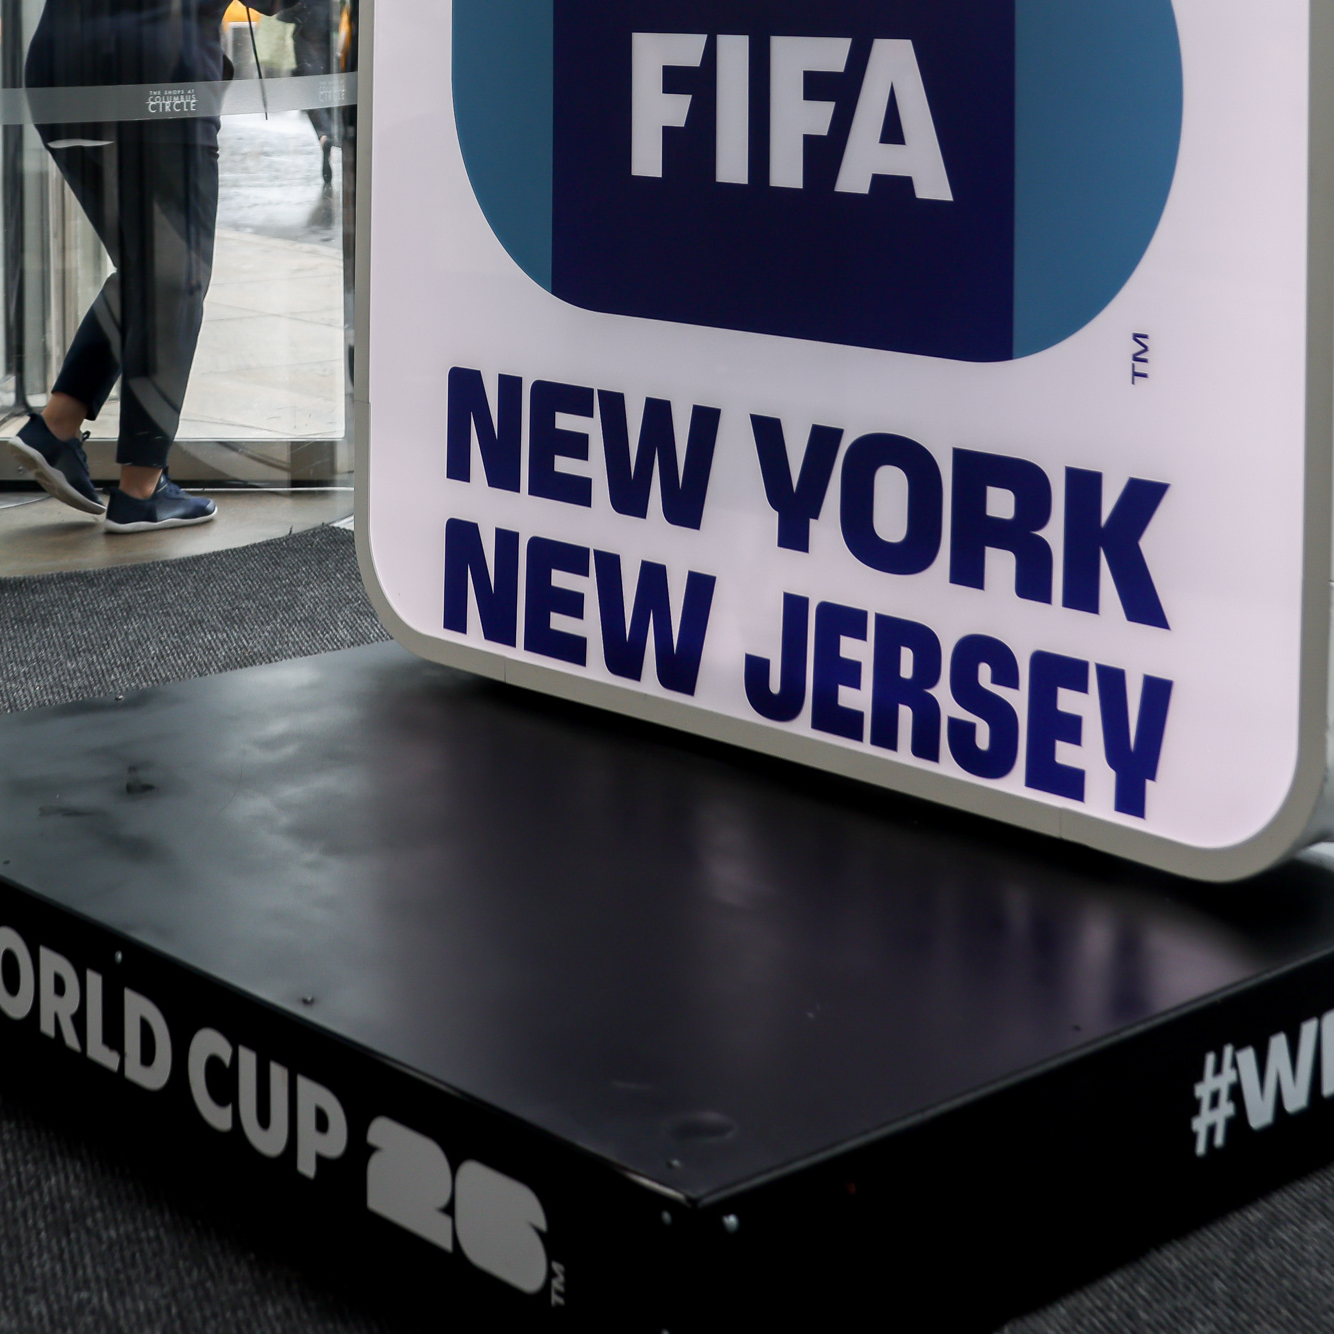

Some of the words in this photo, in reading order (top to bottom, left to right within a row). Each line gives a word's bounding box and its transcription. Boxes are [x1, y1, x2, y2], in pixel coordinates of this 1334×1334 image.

[148, 95, 196, 103] COLUMBUS
[148, 100, 196, 113] CIRCLE
[631, 32, 954, 201] FIFA
[1131, 332, 1149, 385] TM
[446, 366, 721, 531] NEW
[749, 413, 1171, 631] YORK
[443, 517, 716, 696] NEW
[744, 591, 1174, 820] JERSEY
[187, 1027, 348, 1180] CUP
[366, 1115, 548, 1295] 26
